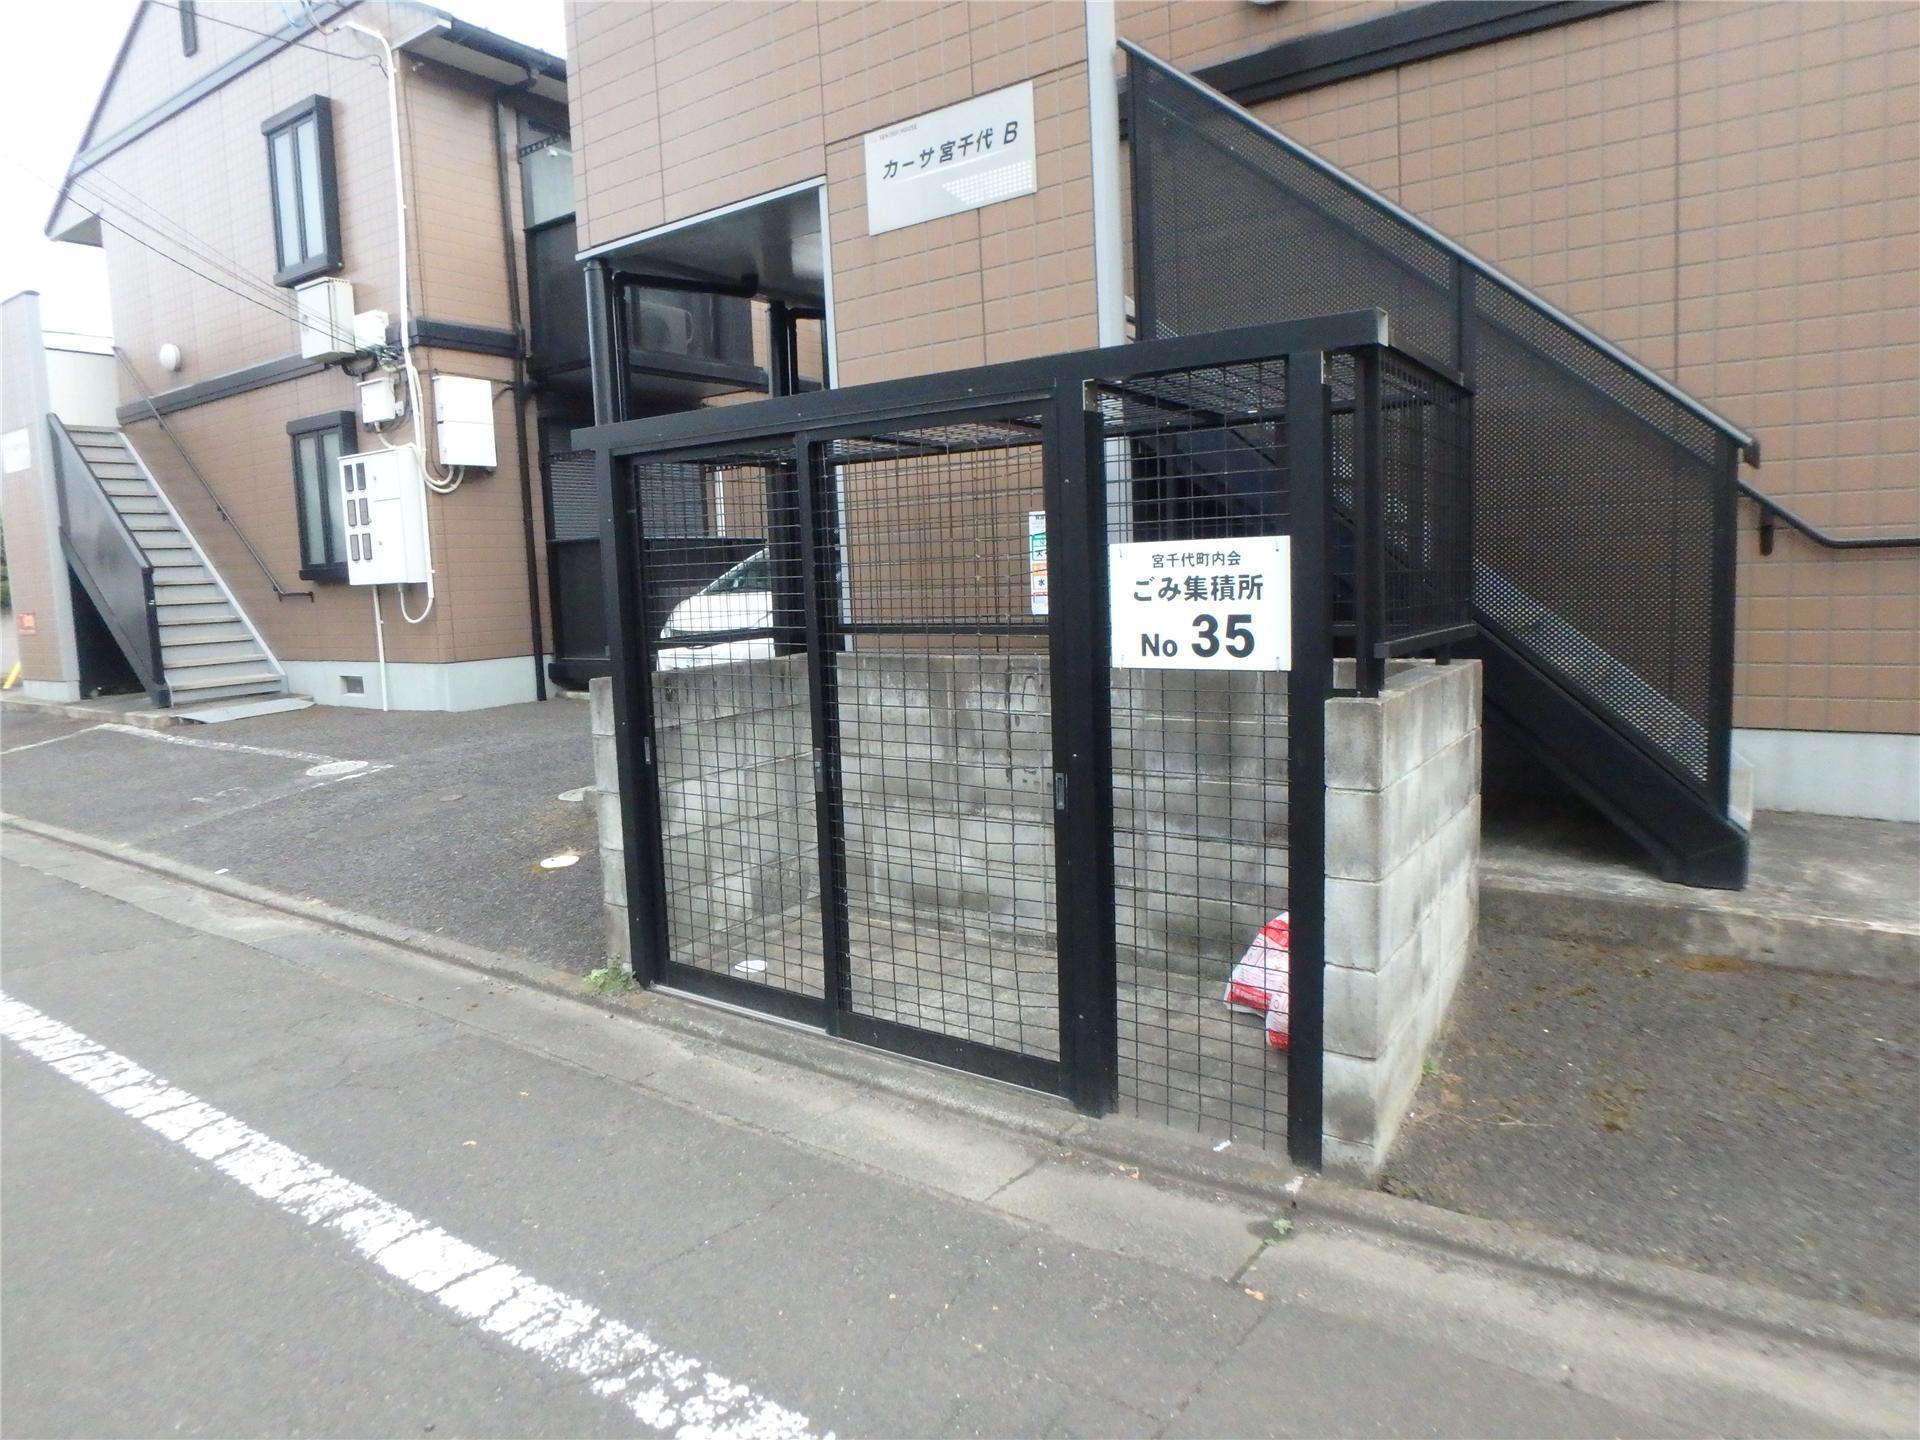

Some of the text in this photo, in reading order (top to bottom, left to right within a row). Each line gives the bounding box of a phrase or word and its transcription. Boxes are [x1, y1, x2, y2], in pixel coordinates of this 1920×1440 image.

[883, 128, 993, 180] カーサ宮千代
[1003, 121, 1018, 145] B
[1151, 550, 1241, 569] 宮千代町内会
[1133, 574, 1264, 602] ごみ集積所
[1141, 614, 1255, 658] No 35
